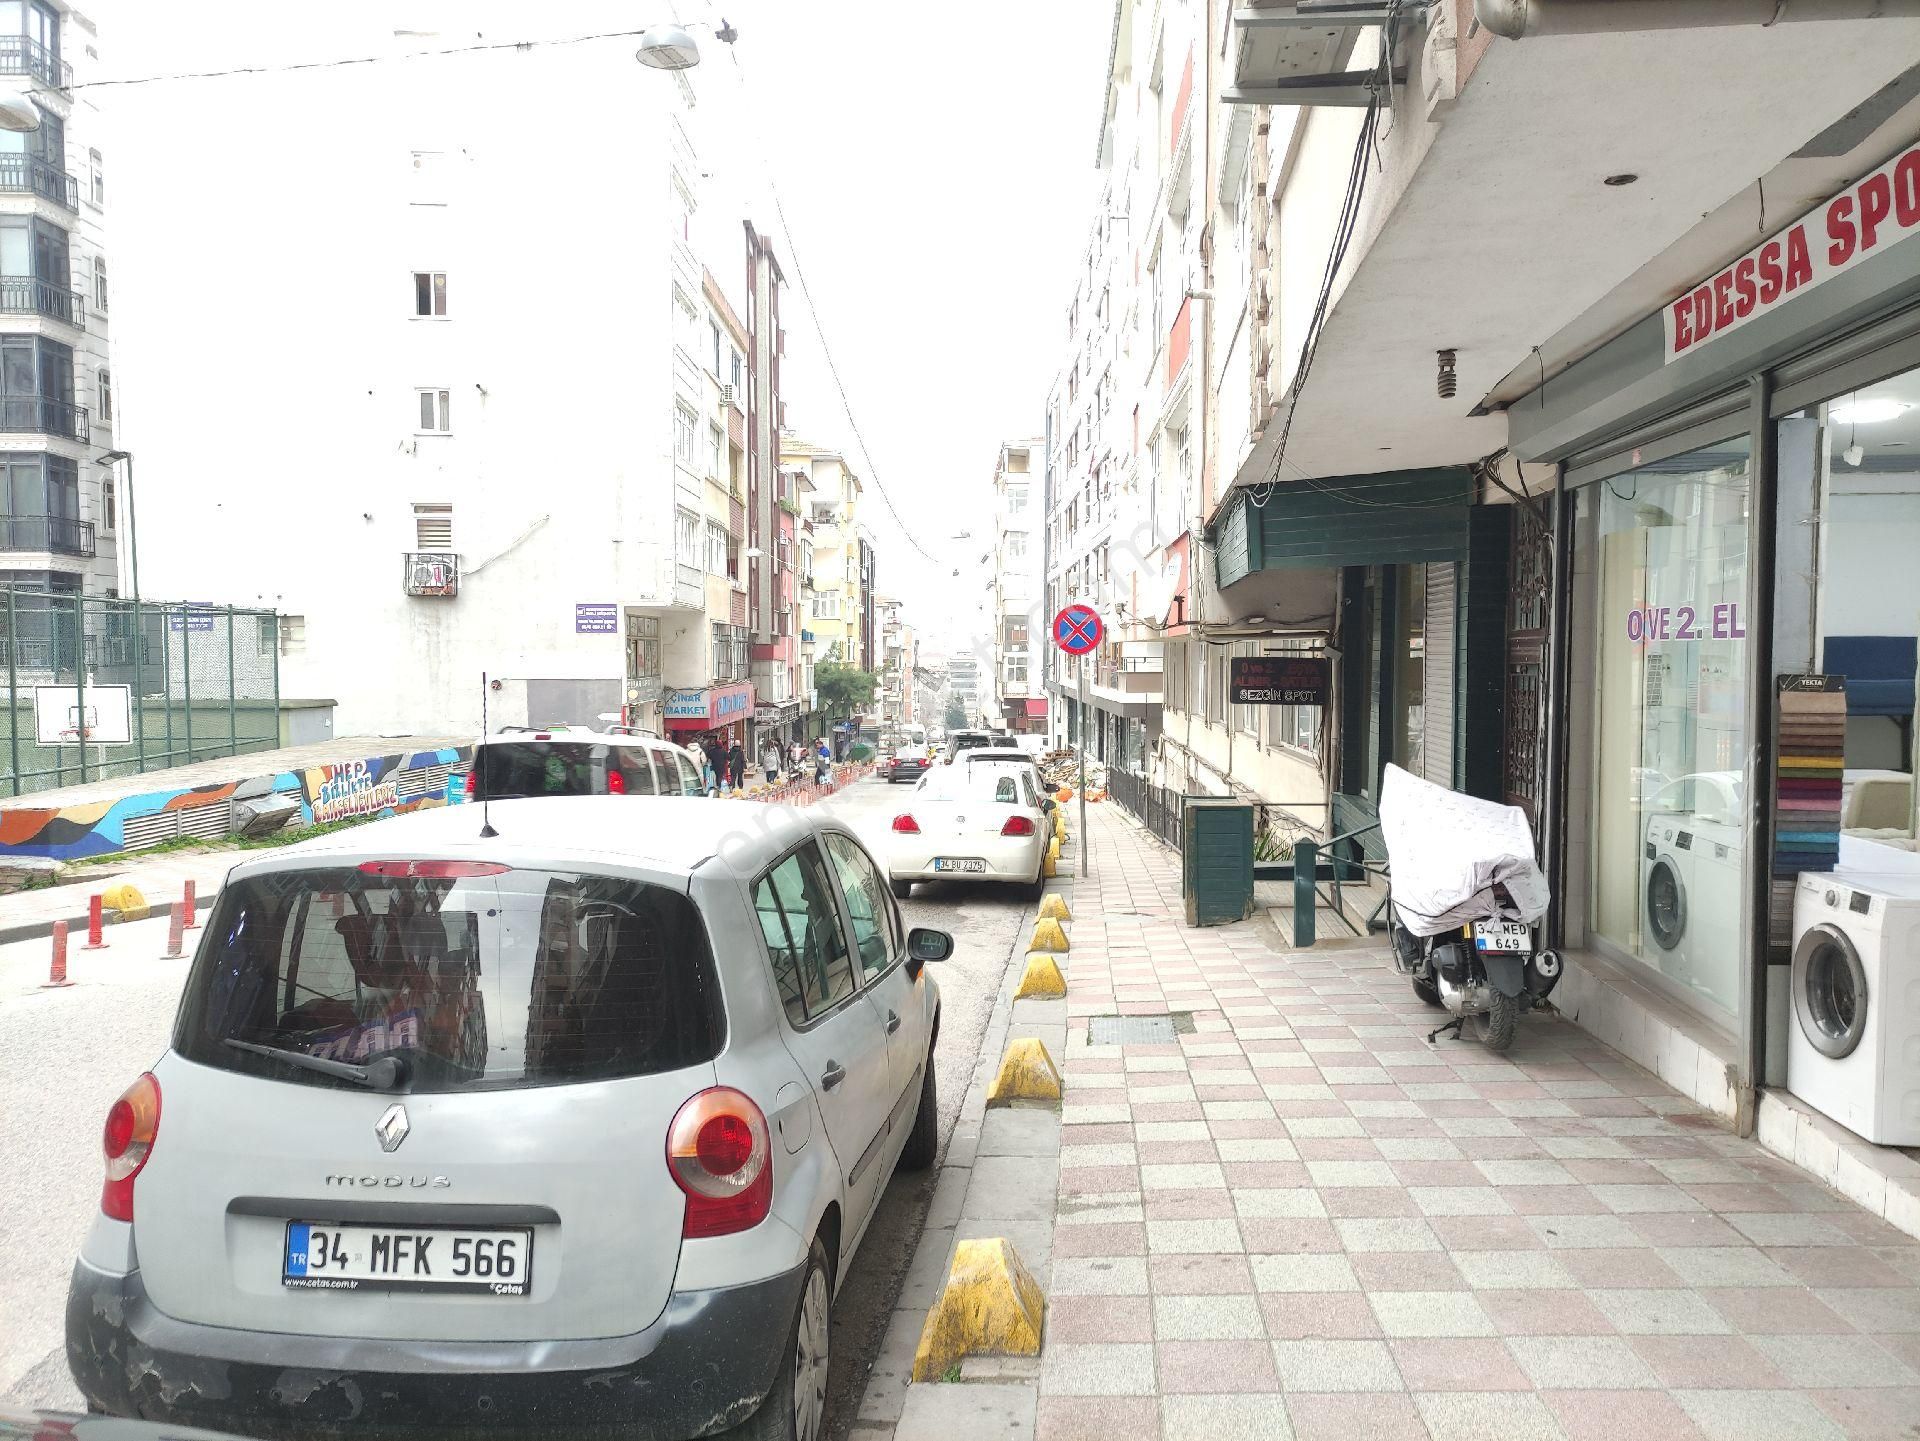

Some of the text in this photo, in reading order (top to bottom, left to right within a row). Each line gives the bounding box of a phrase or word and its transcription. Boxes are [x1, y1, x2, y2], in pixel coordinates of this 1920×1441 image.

[1673, 224, 1813, 353] EDESSA
[1648, 607, 1671, 640] VE
[1712, 603, 1746, 639] EL
[665, 706, 707, 715] MARKET
[333, 761, 367, 783] HEP
[1496, 938, 1520, 949] 649
[292, 1253, 306, 1265] TR
[310, 1232, 517, 1277] 34 MFK 566
